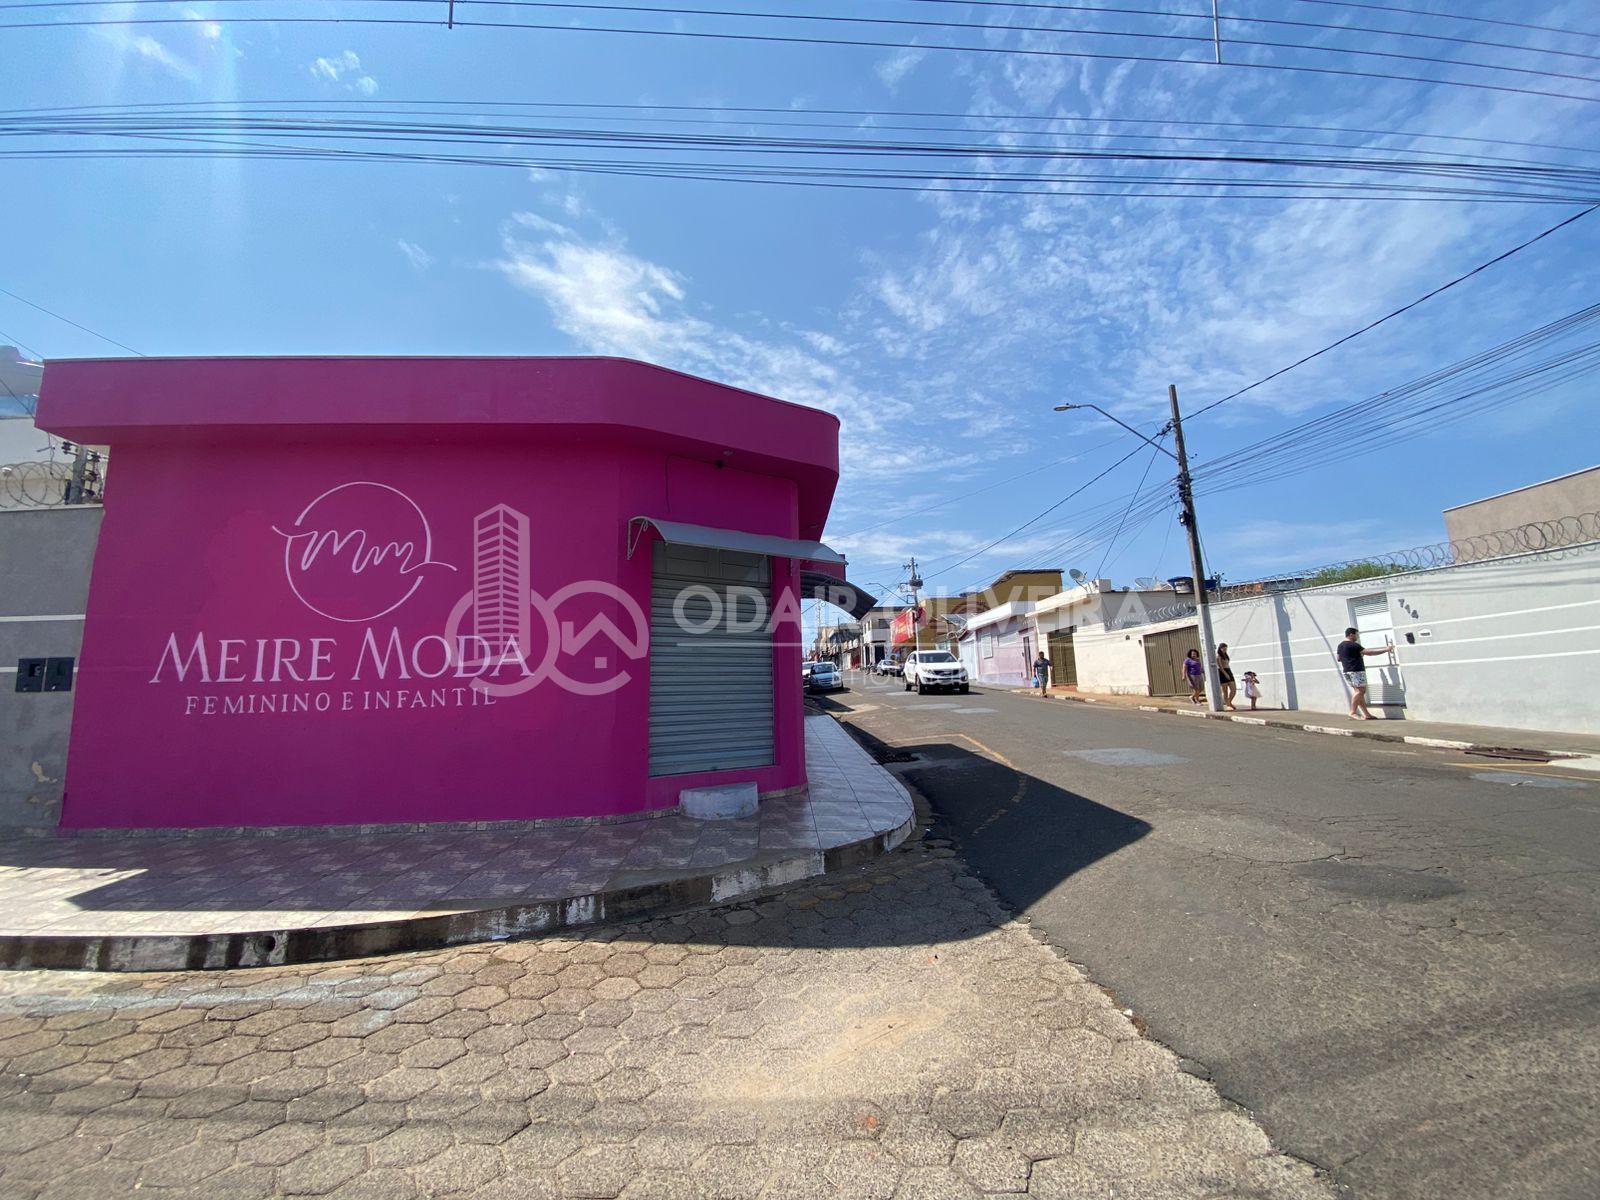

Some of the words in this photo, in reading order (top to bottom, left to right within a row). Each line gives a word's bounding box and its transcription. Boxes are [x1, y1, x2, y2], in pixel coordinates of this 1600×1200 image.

[185, 692, 331, 715] FEMININO
[341, 691, 354, 711] E
[363, 687, 497, 710] INFANTIL
